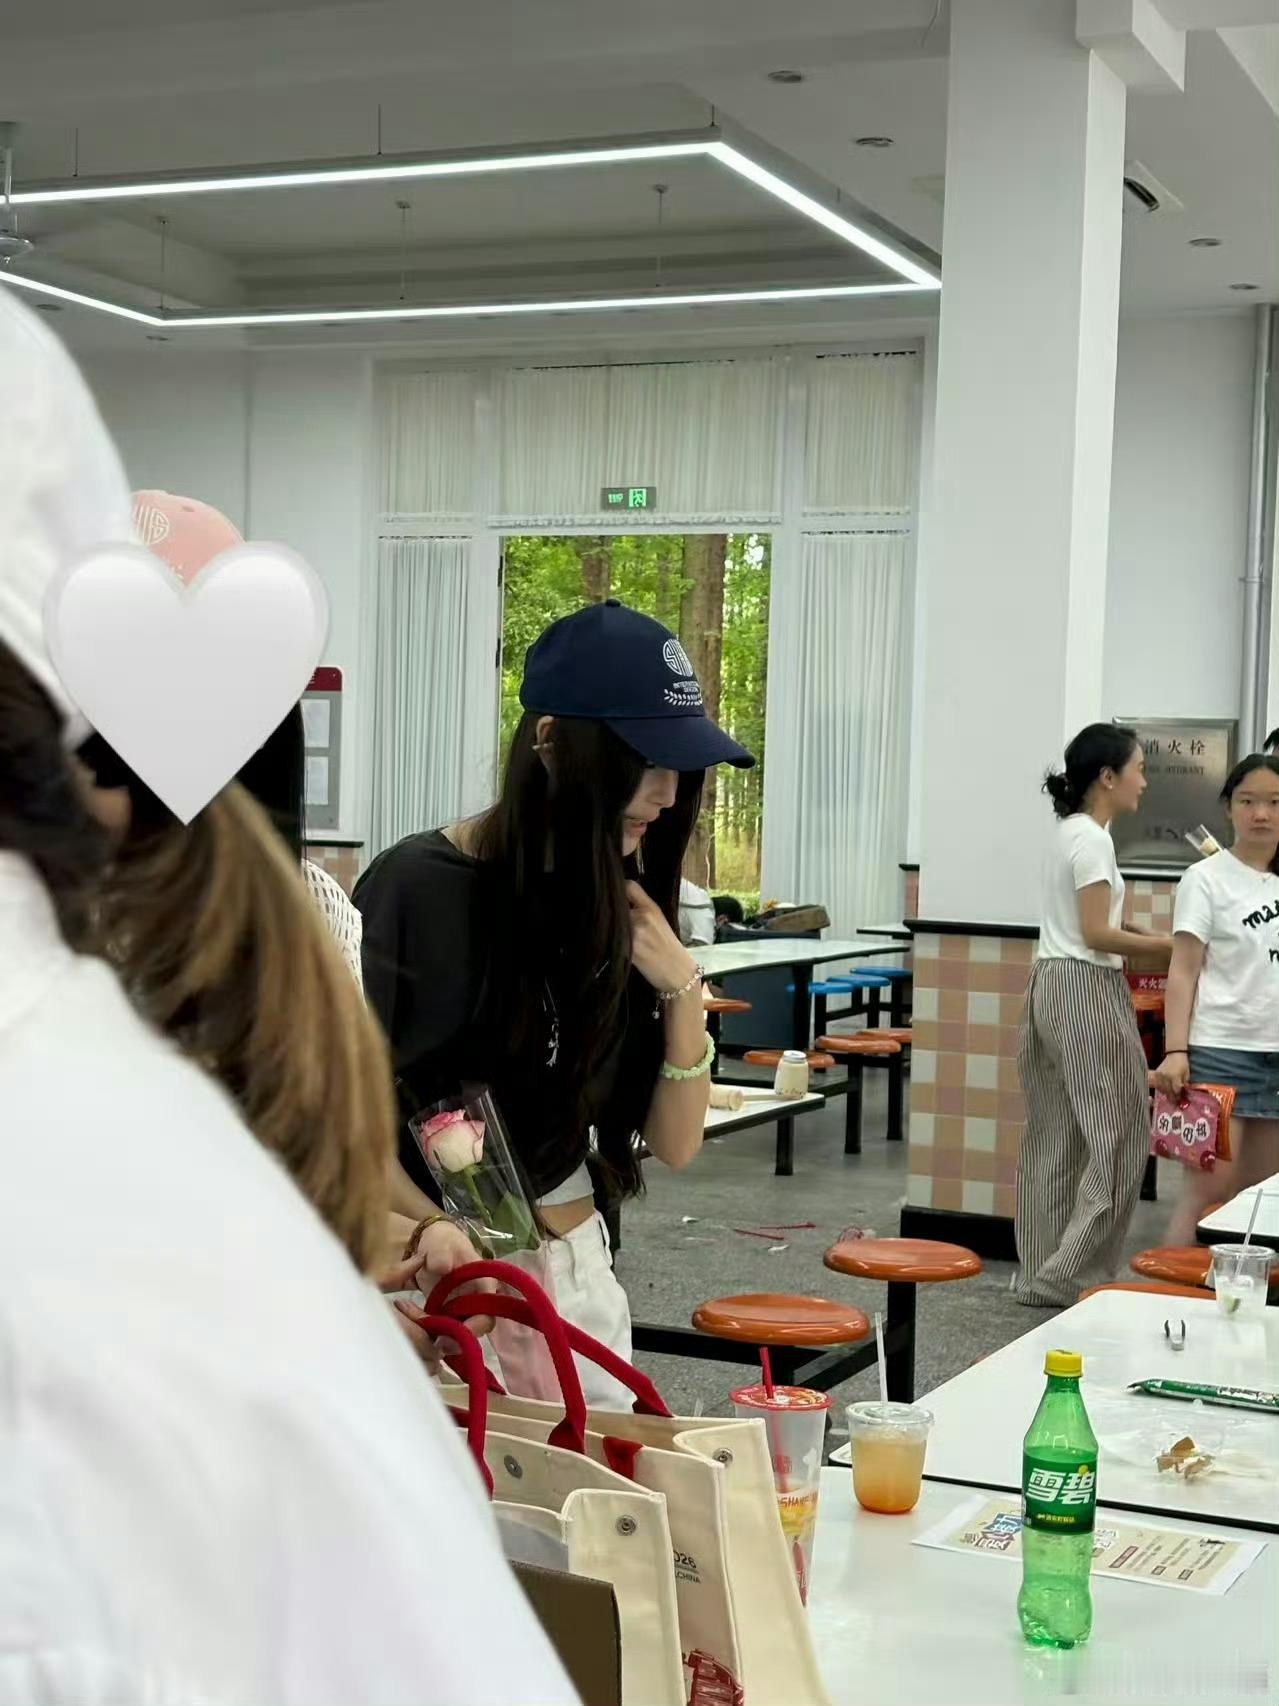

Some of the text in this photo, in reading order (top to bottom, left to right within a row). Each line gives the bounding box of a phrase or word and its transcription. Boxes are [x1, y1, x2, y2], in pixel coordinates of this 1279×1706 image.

[1145, 738, 1205, 756] 消火栓
[1026, 1467, 1095, 1505] 雪碧
